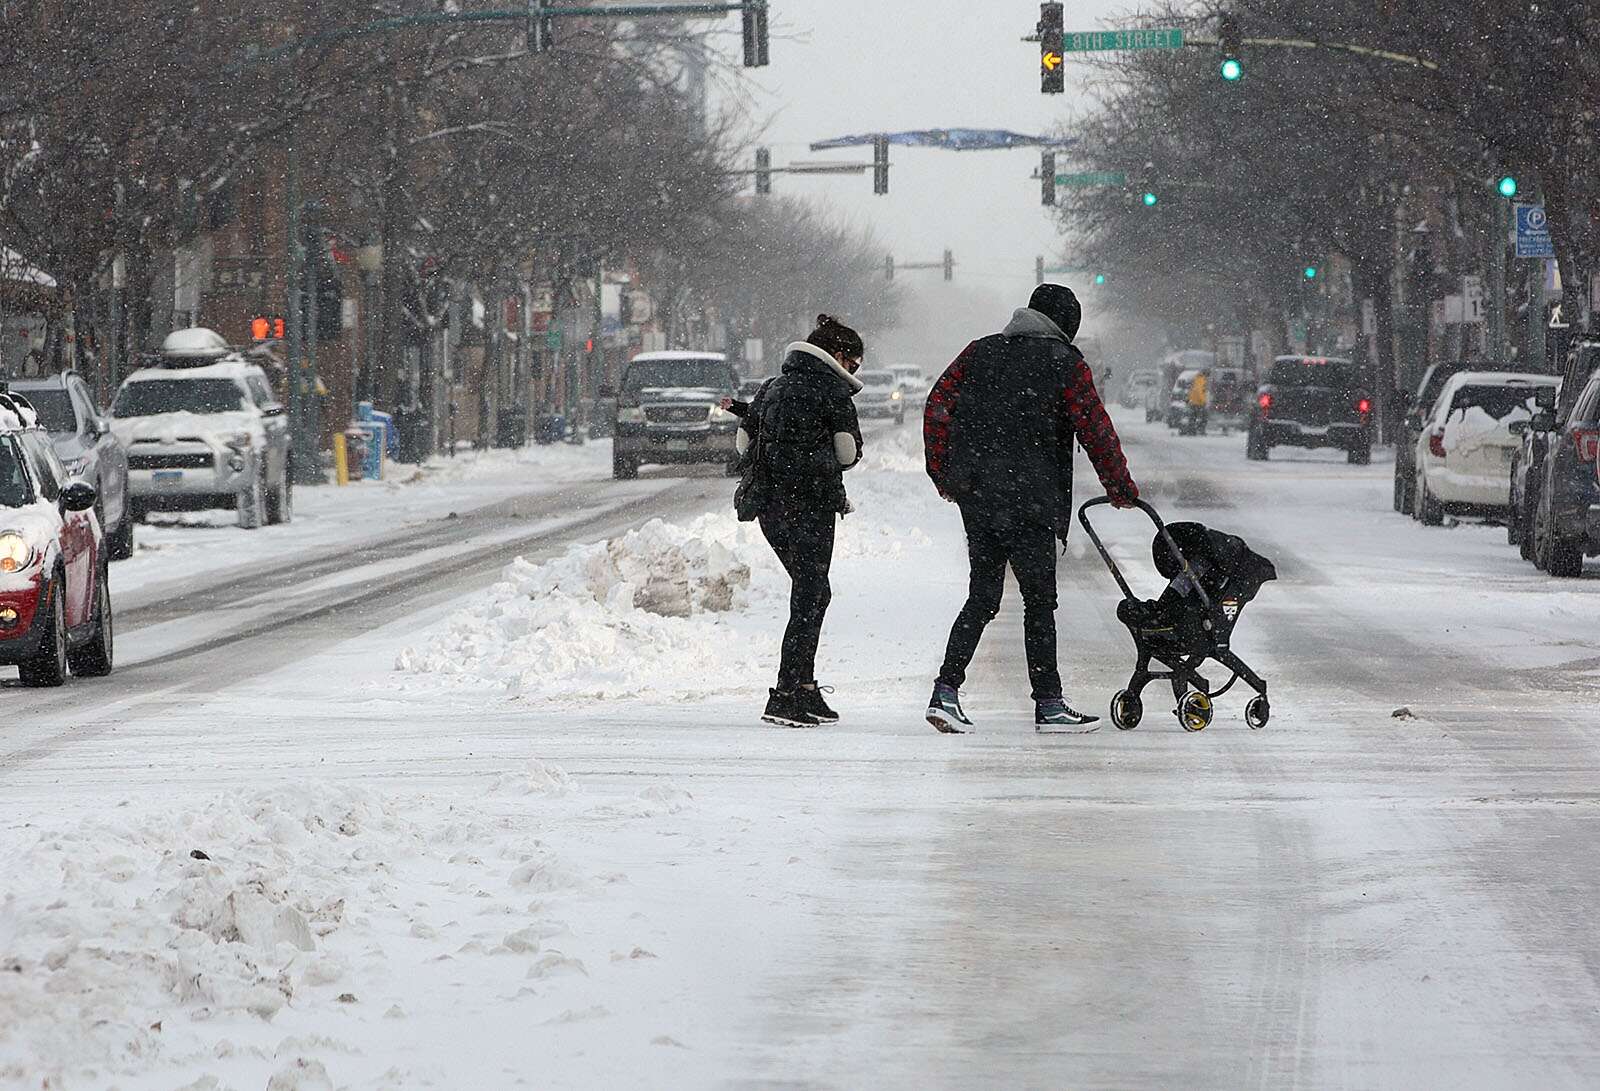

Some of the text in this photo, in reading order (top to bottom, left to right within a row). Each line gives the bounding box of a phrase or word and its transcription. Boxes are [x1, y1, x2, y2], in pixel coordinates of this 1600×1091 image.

[1072, 30, 1171, 49] 8TH STREET
[1532, 212, 1542, 224] P
